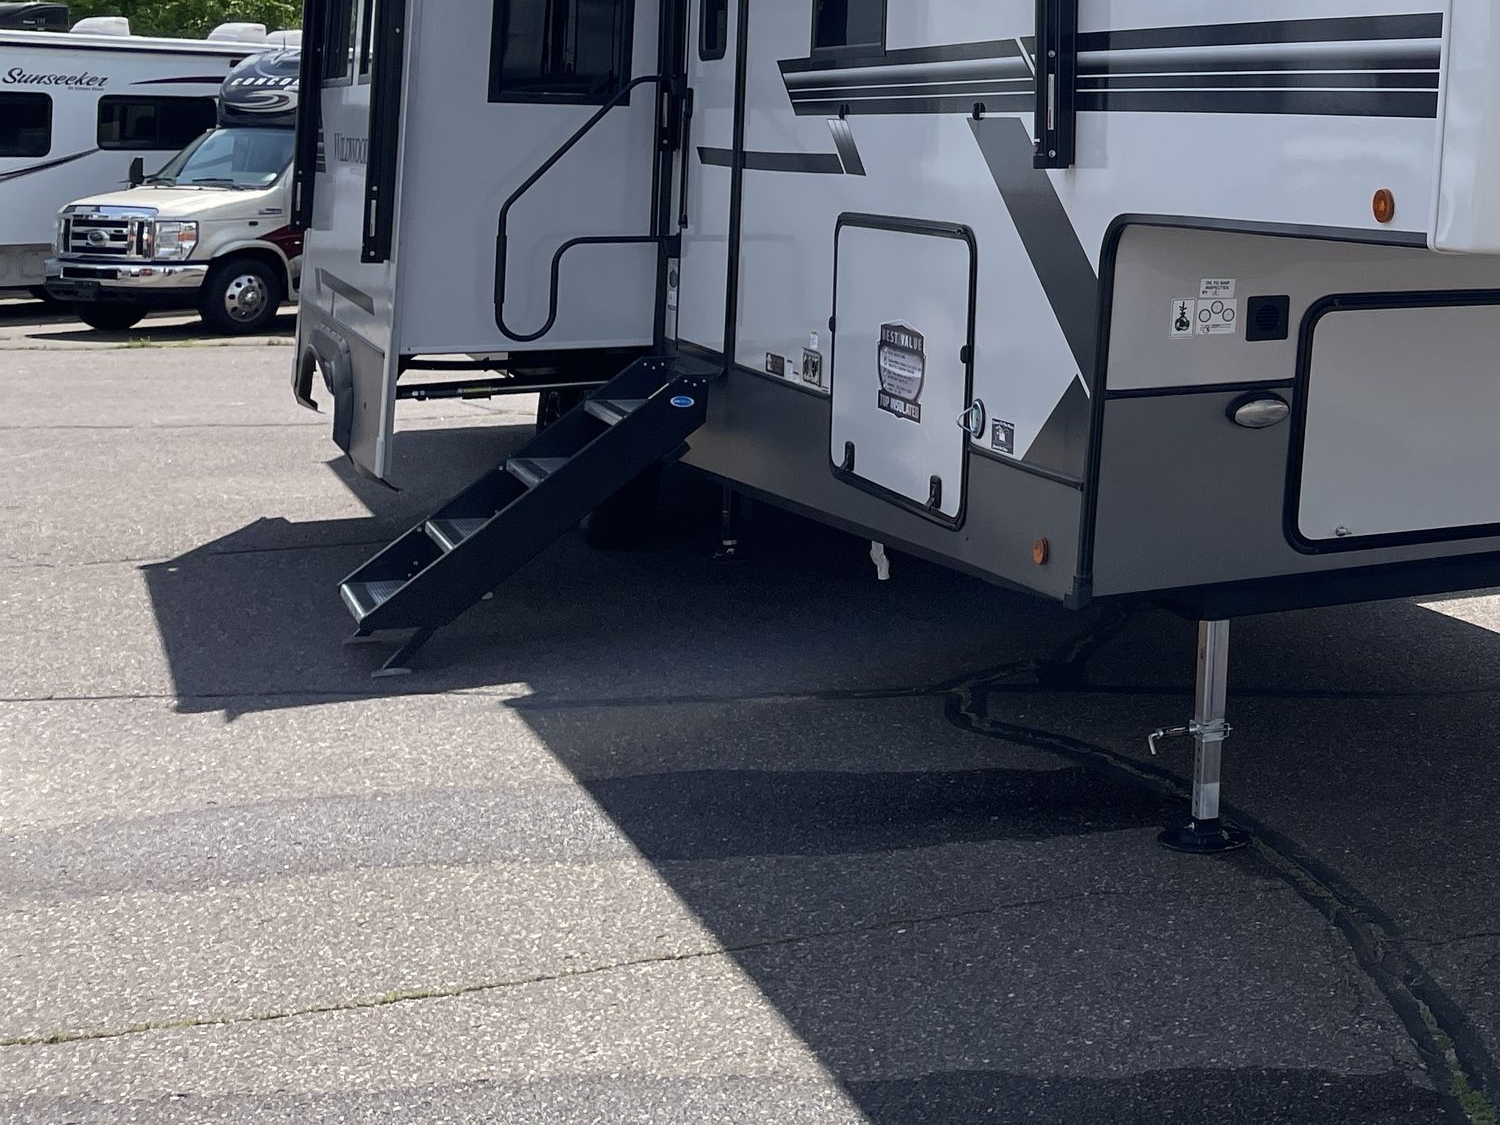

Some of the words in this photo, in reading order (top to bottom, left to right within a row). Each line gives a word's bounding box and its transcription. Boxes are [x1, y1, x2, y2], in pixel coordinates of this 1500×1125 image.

[2, 67, 109, 87] Sunseeker
[882, 328, 898, 344] BEST
[900, 333, 922, 351] VALUE
[880, 394, 890, 408] TOP
[890, 397, 920, 419] INSULATED
